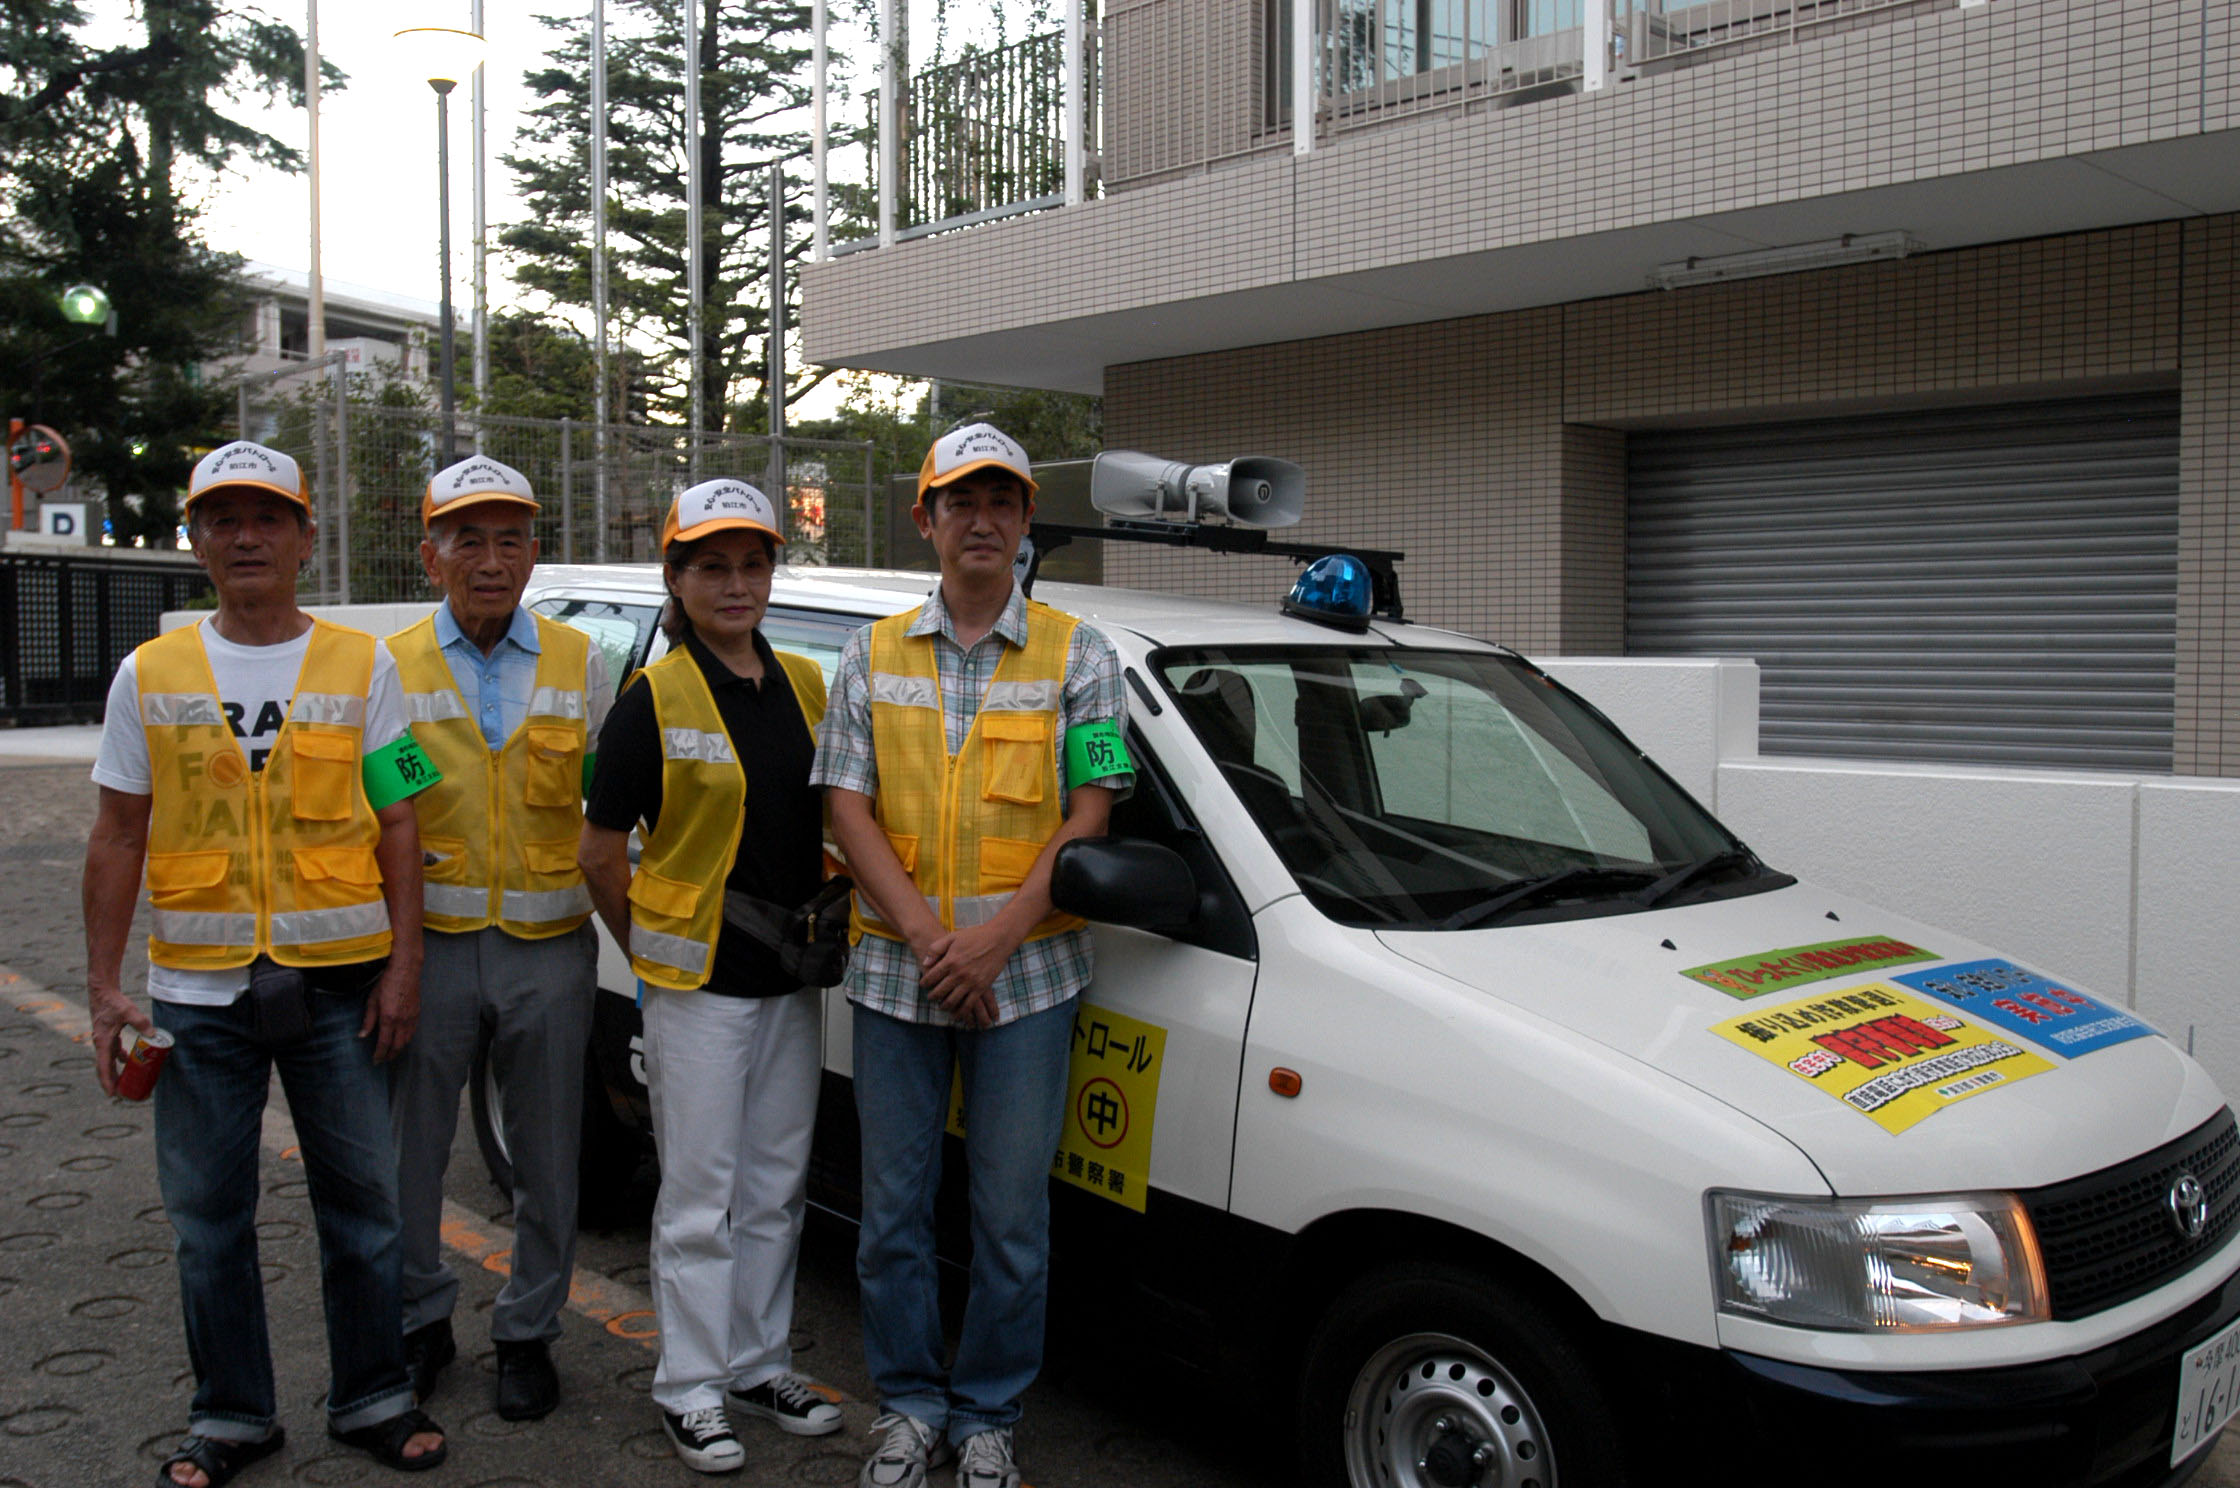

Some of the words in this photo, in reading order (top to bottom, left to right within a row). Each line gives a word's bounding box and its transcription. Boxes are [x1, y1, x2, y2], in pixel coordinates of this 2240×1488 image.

[52, 512, 74, 535] D
[394, 752, 426, 785] 防
[1085, 738, 1115, 768] 防
[1086, 1090, 1119, 1136] 中
[2194, 1363, 2240, 1444] 16-1
